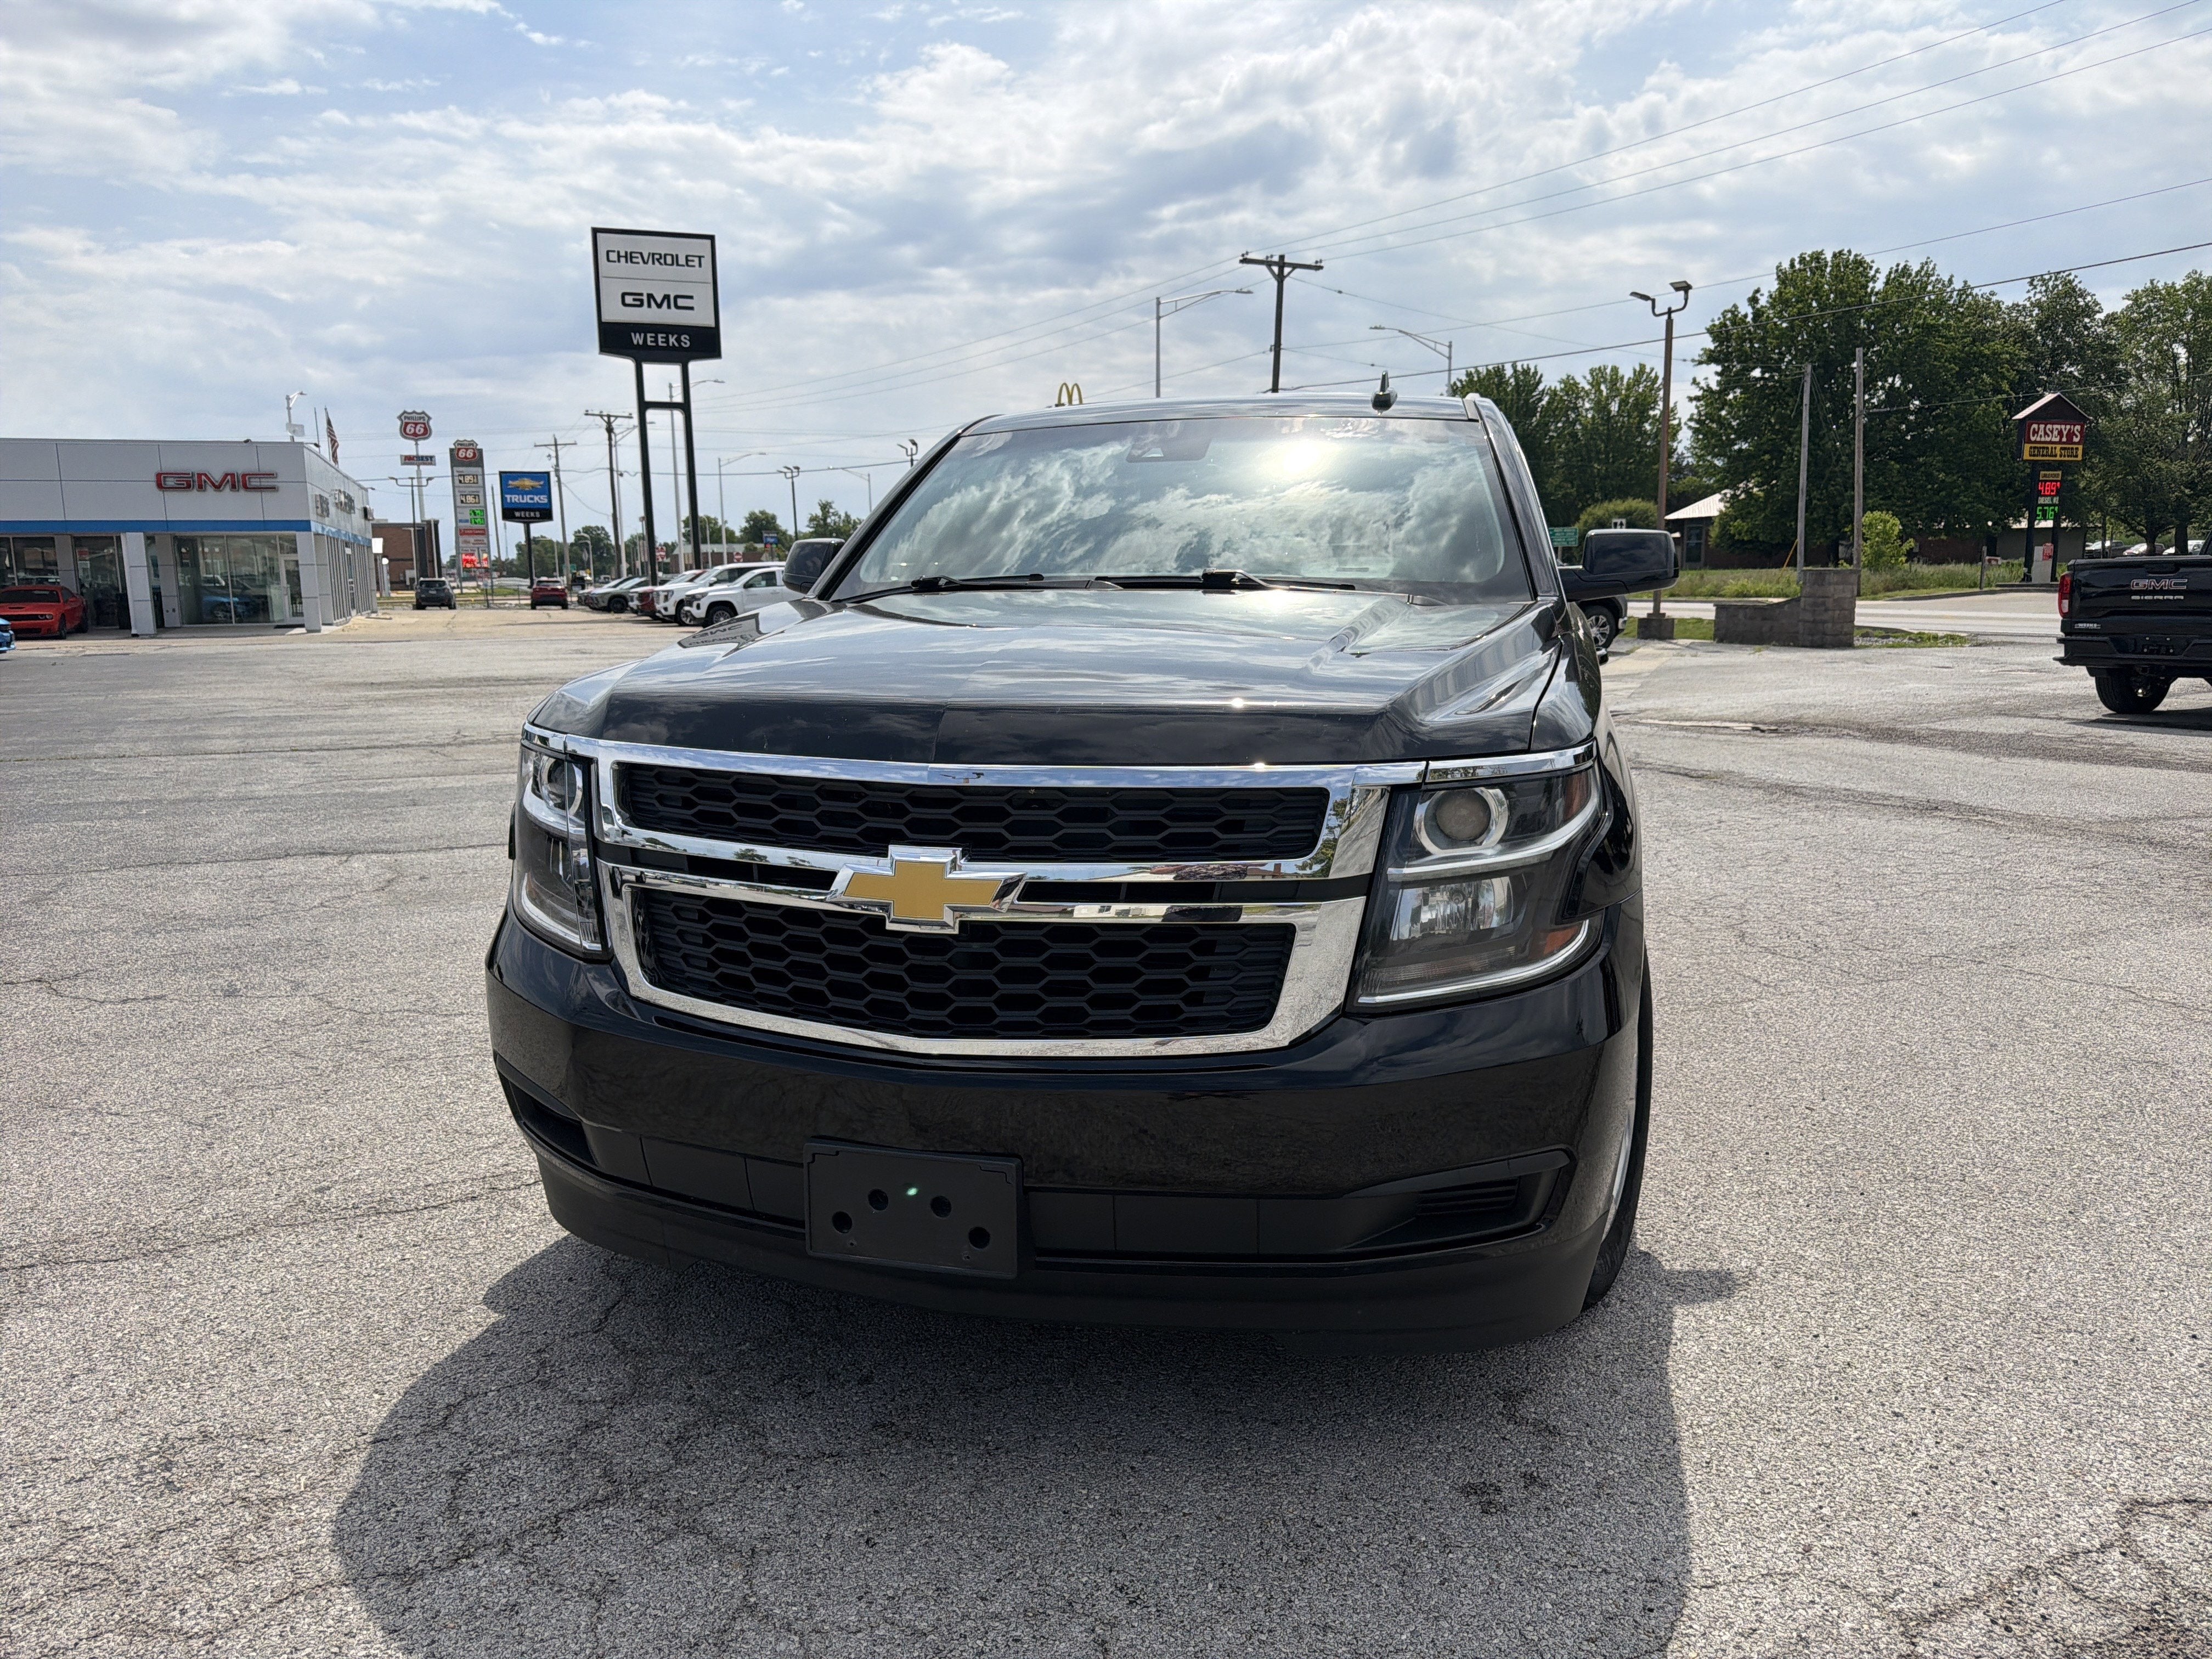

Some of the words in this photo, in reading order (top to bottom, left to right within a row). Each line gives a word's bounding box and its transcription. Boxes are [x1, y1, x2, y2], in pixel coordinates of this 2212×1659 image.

[606, 250, 705, 268] CHEVROLET
[620, 291, 695, 311] GMC
[631, 332, 690, 348] WEEKS
[406, 423, 425, 435] 66
[2030, 424, 2081, 442] CASEY'S
[458, 449, 473, 458] 66
[2029, 446, 2058, 458] GENERAL
[2059, 447, 2079, 458] STORE
[156, 472, 279, 492] GMC
[505, 494, 548, 503] TRUCKS
[2131, 579, 2188, 590] GMC
